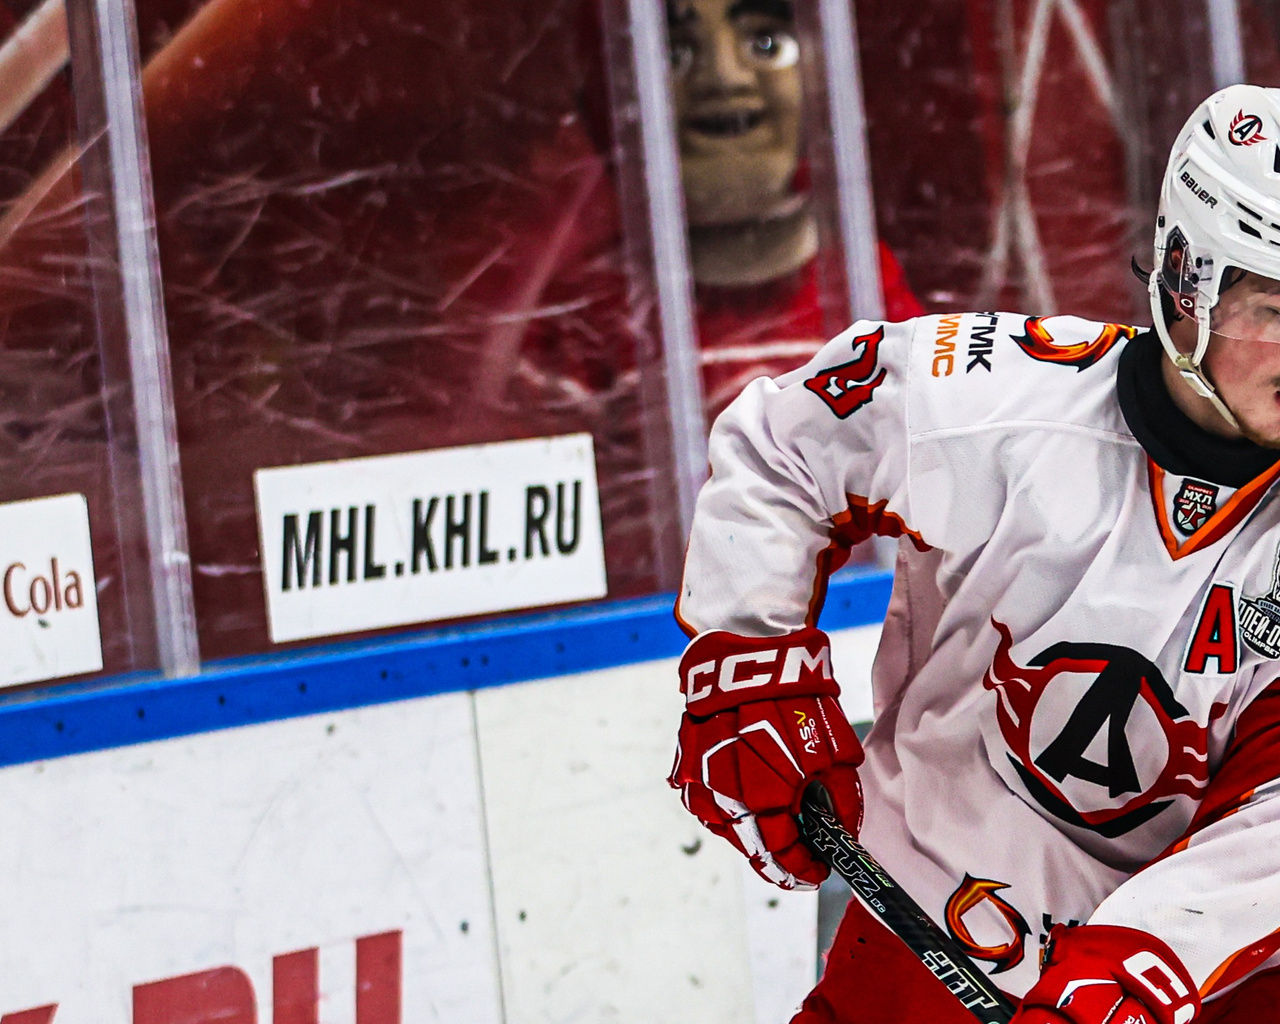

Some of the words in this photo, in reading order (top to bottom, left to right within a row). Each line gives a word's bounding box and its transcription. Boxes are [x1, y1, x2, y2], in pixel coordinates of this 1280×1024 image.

[931, 313, 962, 377] MMC
[1183, 489, 1212, 505] МХЛ
[281, 481, 583, 592] MHL.KHL.RU
[3, 557, 84, 618] Cola
[1184, 583, 1240, 674] A
[1243, 631, 1280, 657] OLIMPBET
[686, 645, 833, 704] CCM
